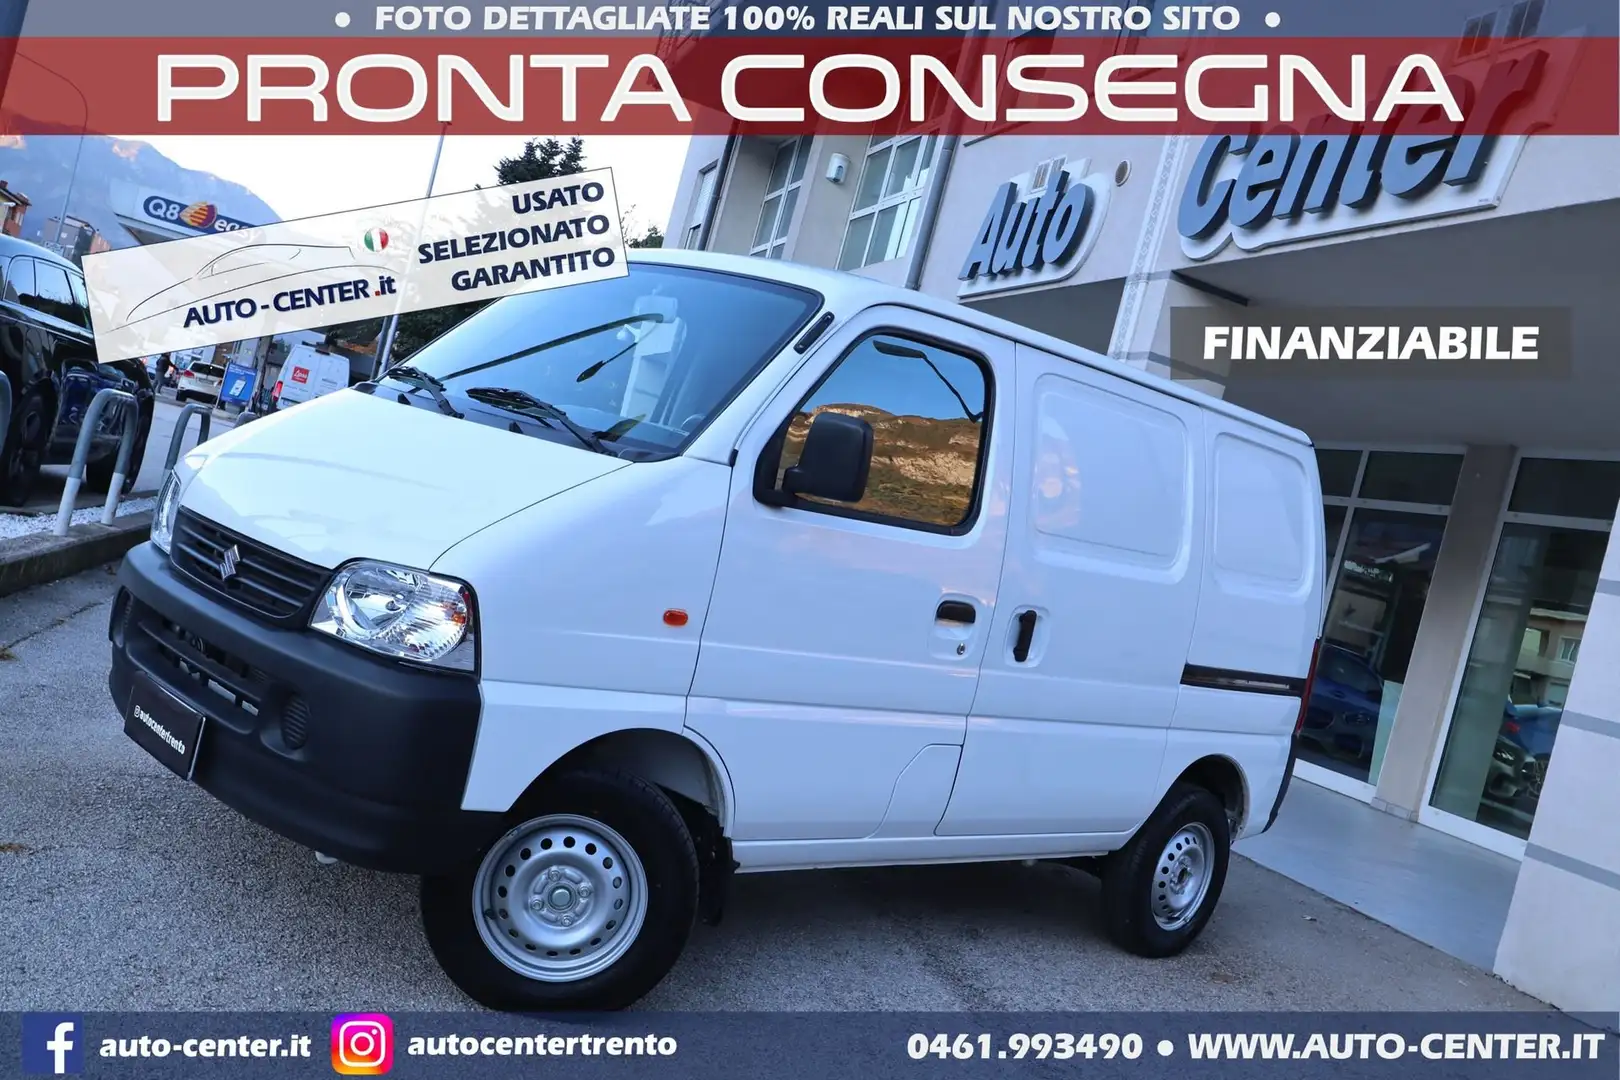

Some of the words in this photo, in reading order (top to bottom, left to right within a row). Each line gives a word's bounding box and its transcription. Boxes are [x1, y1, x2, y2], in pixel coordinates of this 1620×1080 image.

[148, 198, 181, 221] Q8
[958, 170, 1093, 281] Auto
[133, 704, 186, 755] @autocentertrento
